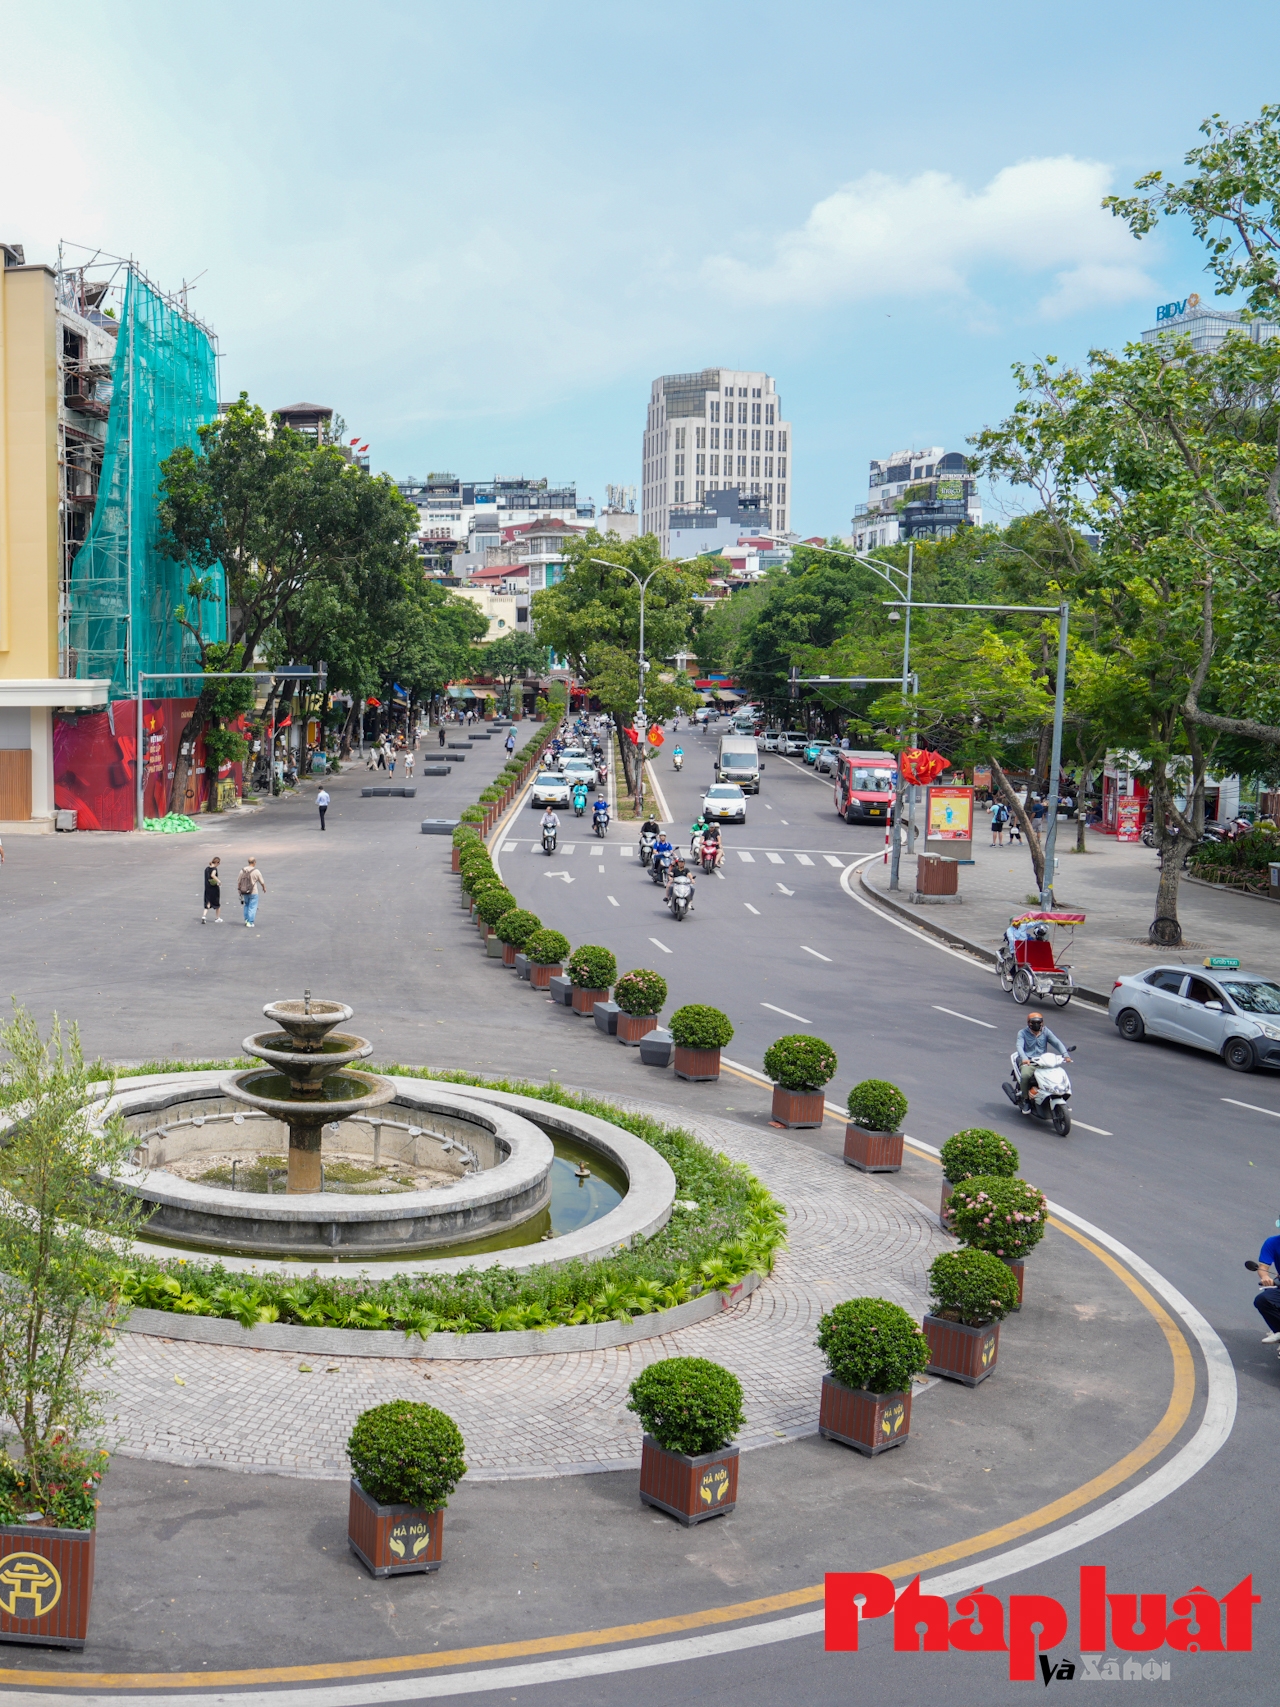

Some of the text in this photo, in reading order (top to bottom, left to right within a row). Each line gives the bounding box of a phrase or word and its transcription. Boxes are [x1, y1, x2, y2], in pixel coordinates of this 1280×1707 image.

[1156, 299, 1188, 321] BIDV
[703, 1469, 727, 1485] HÀ NỘI
[393, 1522, 426, 1537] HÀ NỘI
